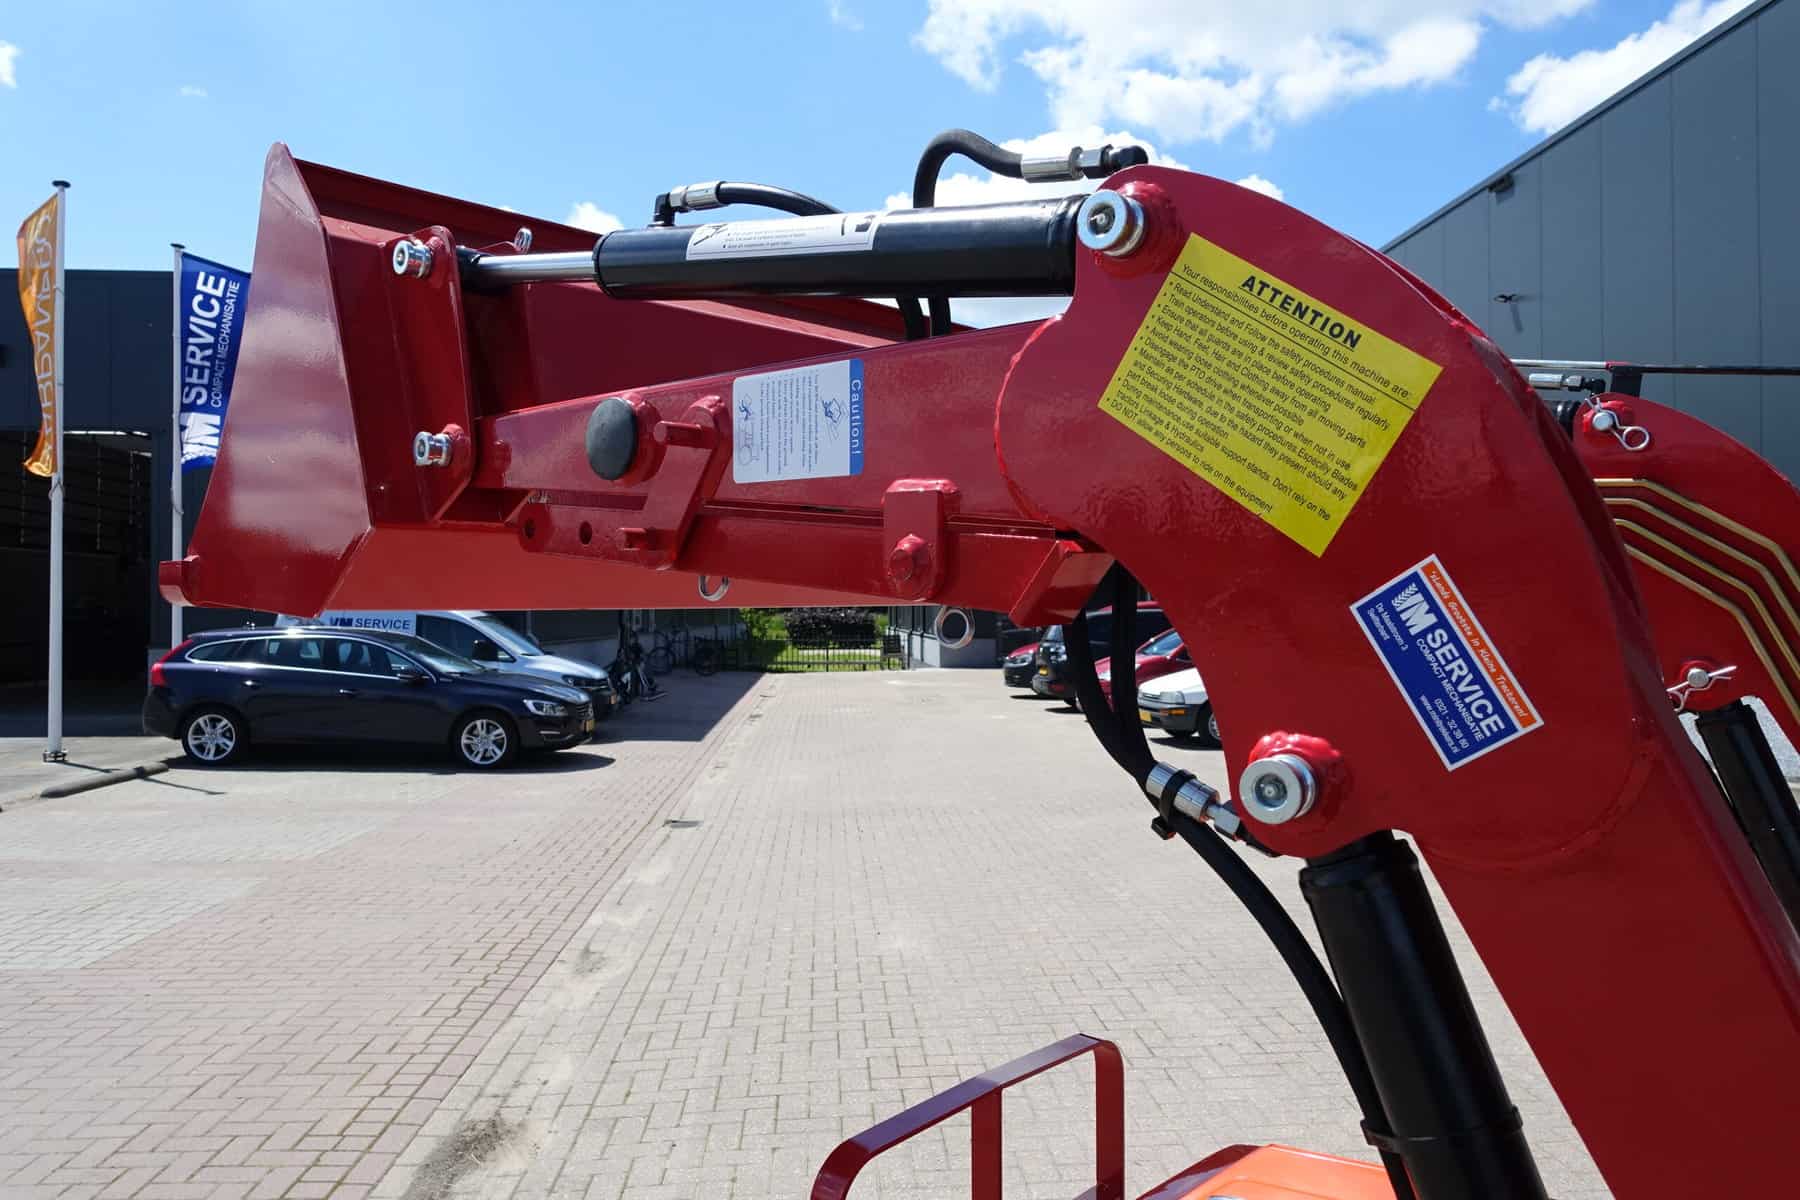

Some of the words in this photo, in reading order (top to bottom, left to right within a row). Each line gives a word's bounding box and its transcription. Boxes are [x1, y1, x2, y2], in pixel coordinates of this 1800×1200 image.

[183, 271, 227, 406] SERVICE
[210, 360, 226, 408] COMPACT
[218, 279, 240, 360] MECHANISATIE
[1161, 304, 1185, 324] Ensure
[1271, 370, 1295, 390] before
[1172, 282, 1192, 299] Read
[1190, 292, 1230, 321] Understand
[1229, 317, 1245, 329] and
[1243, 323, 1267, 343] Follow
[1266, 336, 1280, 350] the
[1280, 346, 1303, 365] safety
[1301, 359, 1345, 388] procedures
[1181, 263, 1200, 280] Your
[1199, 276, 1259, 314] responsibilities
[1259, 308, 1288, 330] before
[1288, 326, 1331, 356] operating
[1330, 348, 1349, 364] this
[1349, 360, 1390, 388] machine
[1240, 273, 1362, 349] ATTENTION
[1215, 322, 1238, 341] before
[1237, 337, 1258, 354] using
[1288, 366, 1312, 386] safety
[1310, 380, 1355, 410] procedures
[1239, 366, 1269, 391] Clothing
[1269, 385, 1289, 403] away
[1288, 395, 1308, 412] from
[1317, 414, 1346, 437] moving
[851, 379, 862, 455] Caution!
[1121, 406, 1137, 421] NOT
[1188, 365, 1206, 380] PTO
[1204, 374, 1223, 391] drive
[1240, 397, 1283, 431] transporting
[1292, 431, 1313, 448] when
[1312, 444, 1328, 456] not
[1234, 410, 1256, 429] safety
[1271, 404, 1304, 427] possible
[1220, 446, 1247, 466] support
[1305, 502, 1317, 512] on
[1238, 426, 1264, 447] hazard
[1261, 441, 1279, 458] they
[1305, 471, 1332, 490] should
[354, 618, 410, 630] SERVICE
[1414, 637, 1446, 680] COMPACT
[1440, 678, 1485, 742] MECHANISATIE
[1423, 626, 1505, 737] SERVICE
[1432, 697, 1448, 715] 0321
[1446, 718, 1458, 730] 32
